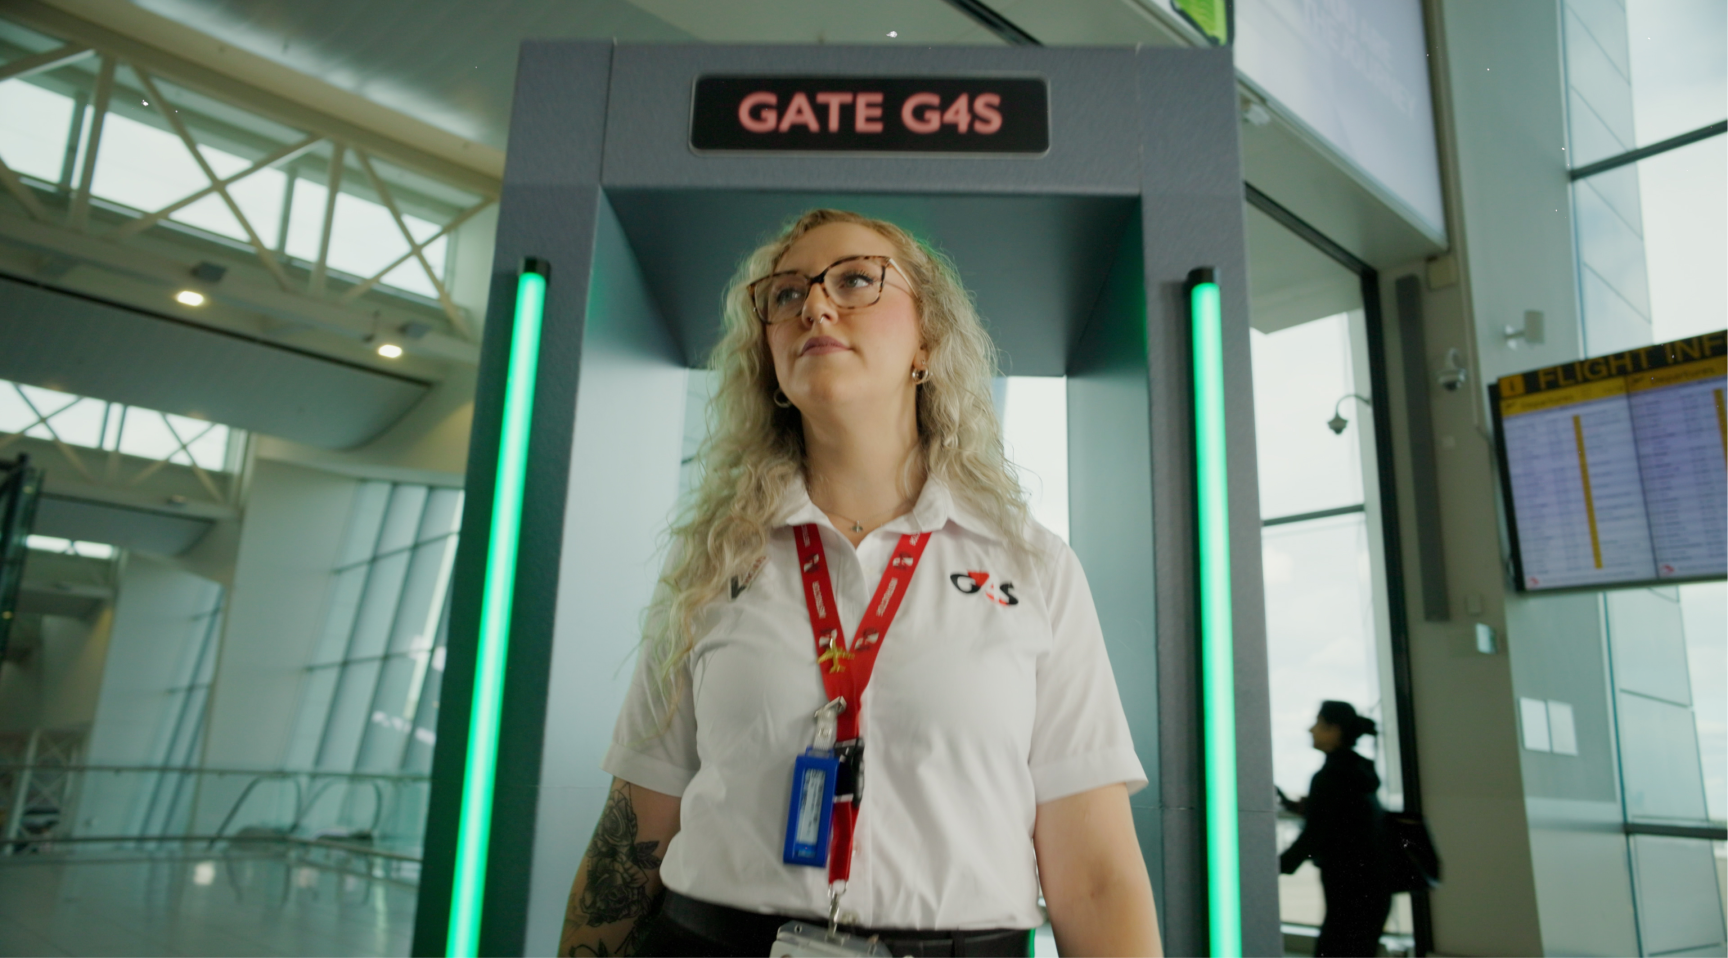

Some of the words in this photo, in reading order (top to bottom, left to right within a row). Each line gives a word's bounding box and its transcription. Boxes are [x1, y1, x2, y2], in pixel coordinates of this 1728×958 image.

[738, 91, 884, 134] GATE
[901, 91, 1003, 135] G4S
[1536, 346, 1653, 391] FLIGHT
[1664, 331, 1728, 364] INF
